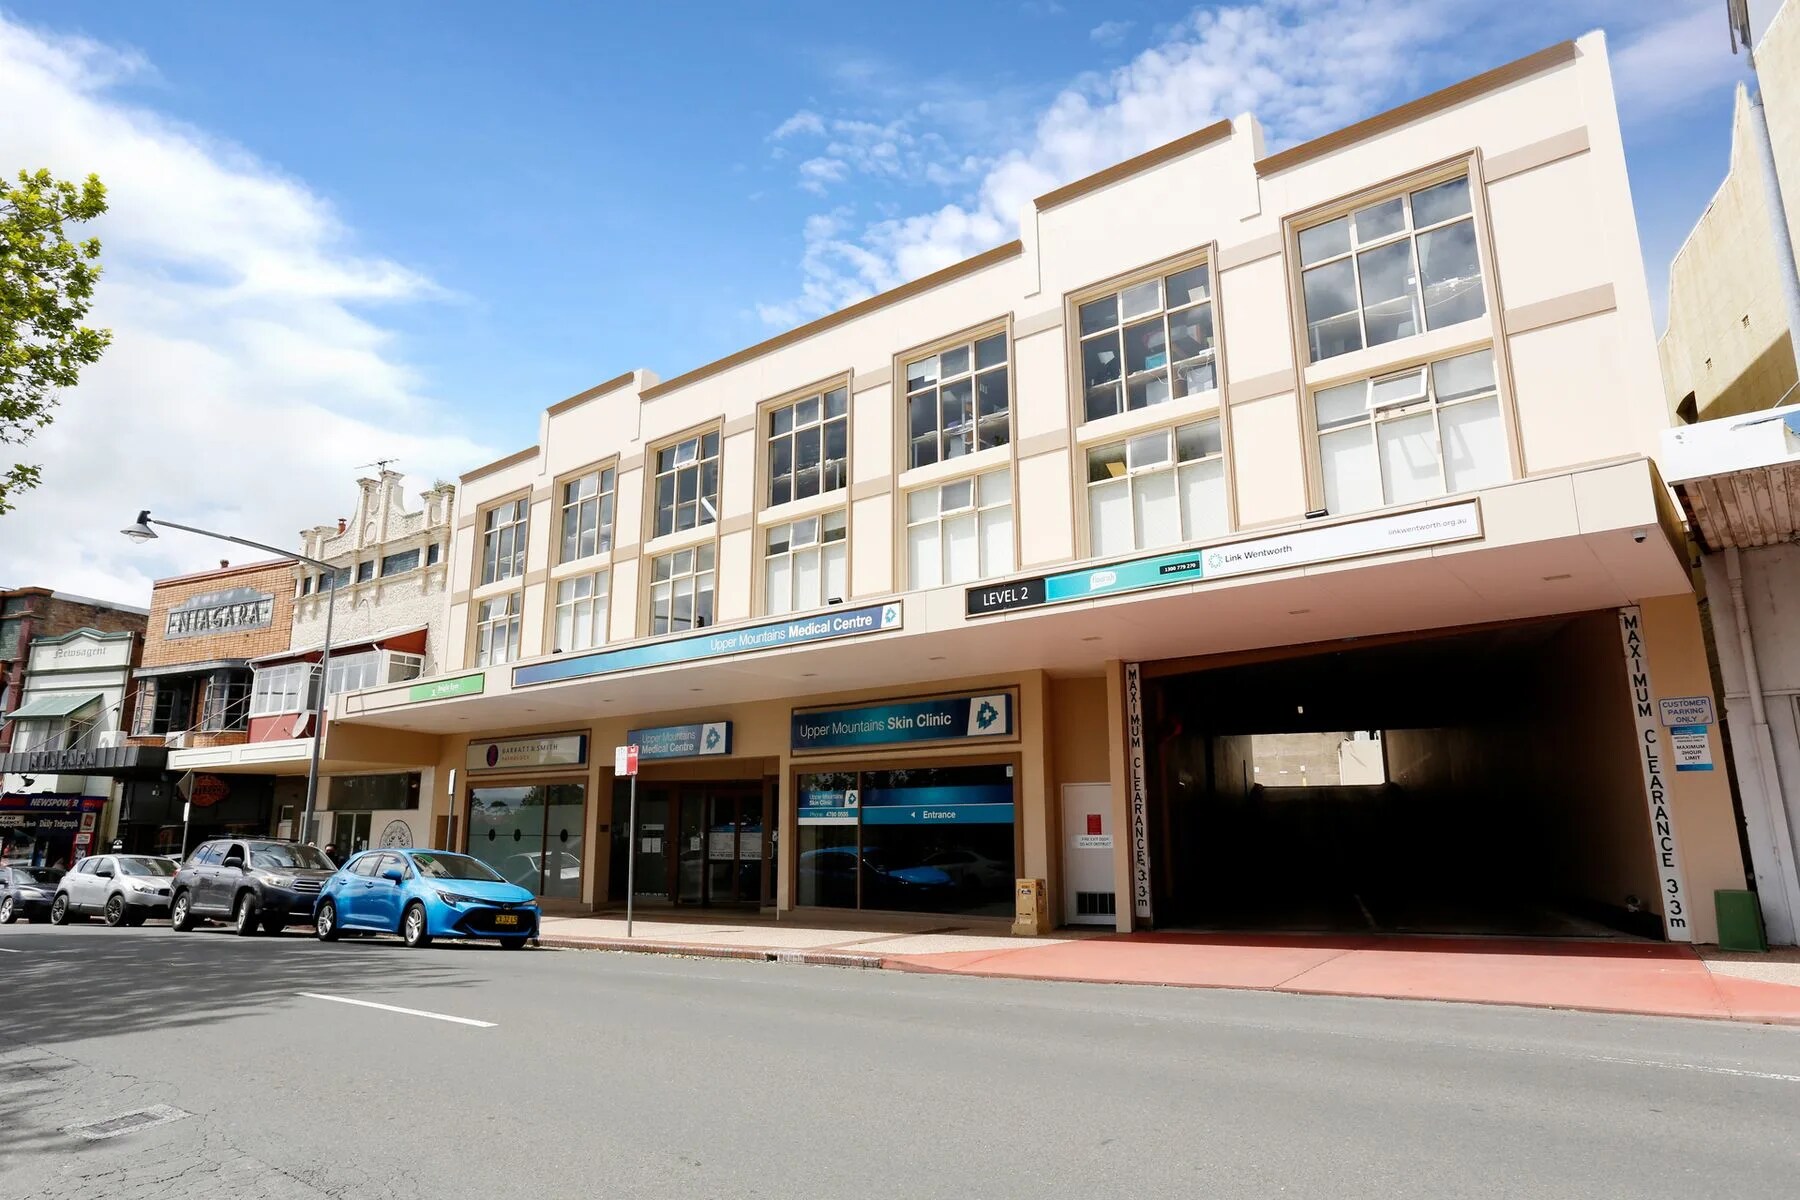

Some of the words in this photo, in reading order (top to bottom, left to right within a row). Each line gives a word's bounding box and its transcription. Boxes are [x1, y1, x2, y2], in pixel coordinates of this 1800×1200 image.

[1388, 518, 1467, 536] linkwentworth.org.au
[1225, 552, 1242, 563] Link
[1243, 544, 1293, 560] Wentworth
[1164, 565, 1177, 573] 1300
[983, 589, 1018, 606] LEVEL
[1020, 587, 1029, 600] 2
[177, 603, 261, 633] NIAGARA
[710, 637, 737, 652] Upper
[739, 629, 786, 647] Mountains
[788, 619, 831, 639] Medical
[833, 614, 873, 633] Centre
[54, 647, 106, 658] Newsagent
[1128, 669, 1141, 748] MAXIMUM
[800, 724, 830, 739] Upper
[832, 719, 885, 734] Mountains
[887, 716, 913, 730] Skin
[916, 713, 952, 727] Clinic
[642, 733, 661, 744] Upper
[662, 731, 696, 741] Mountains
[502, 746, 530, 754] BARRATT
[641, 743, 669, 754] Medical
[669, 742, 694, 752] Centre
[1624, 615, 1652, 717] MAXIMUM
[1644, 729, 1675, 867] CLEARANCE
[1666, 878, 1686, 928] 3.3m
[922, 810, 956, 819] Entrance
[1133, 757, 1145, 862] CLEARANCE
[39, 819, 54, 829] Daily
[54, 819, 79, 830] Telegraph
[1137, 869, 1148, 907] 3.3m
